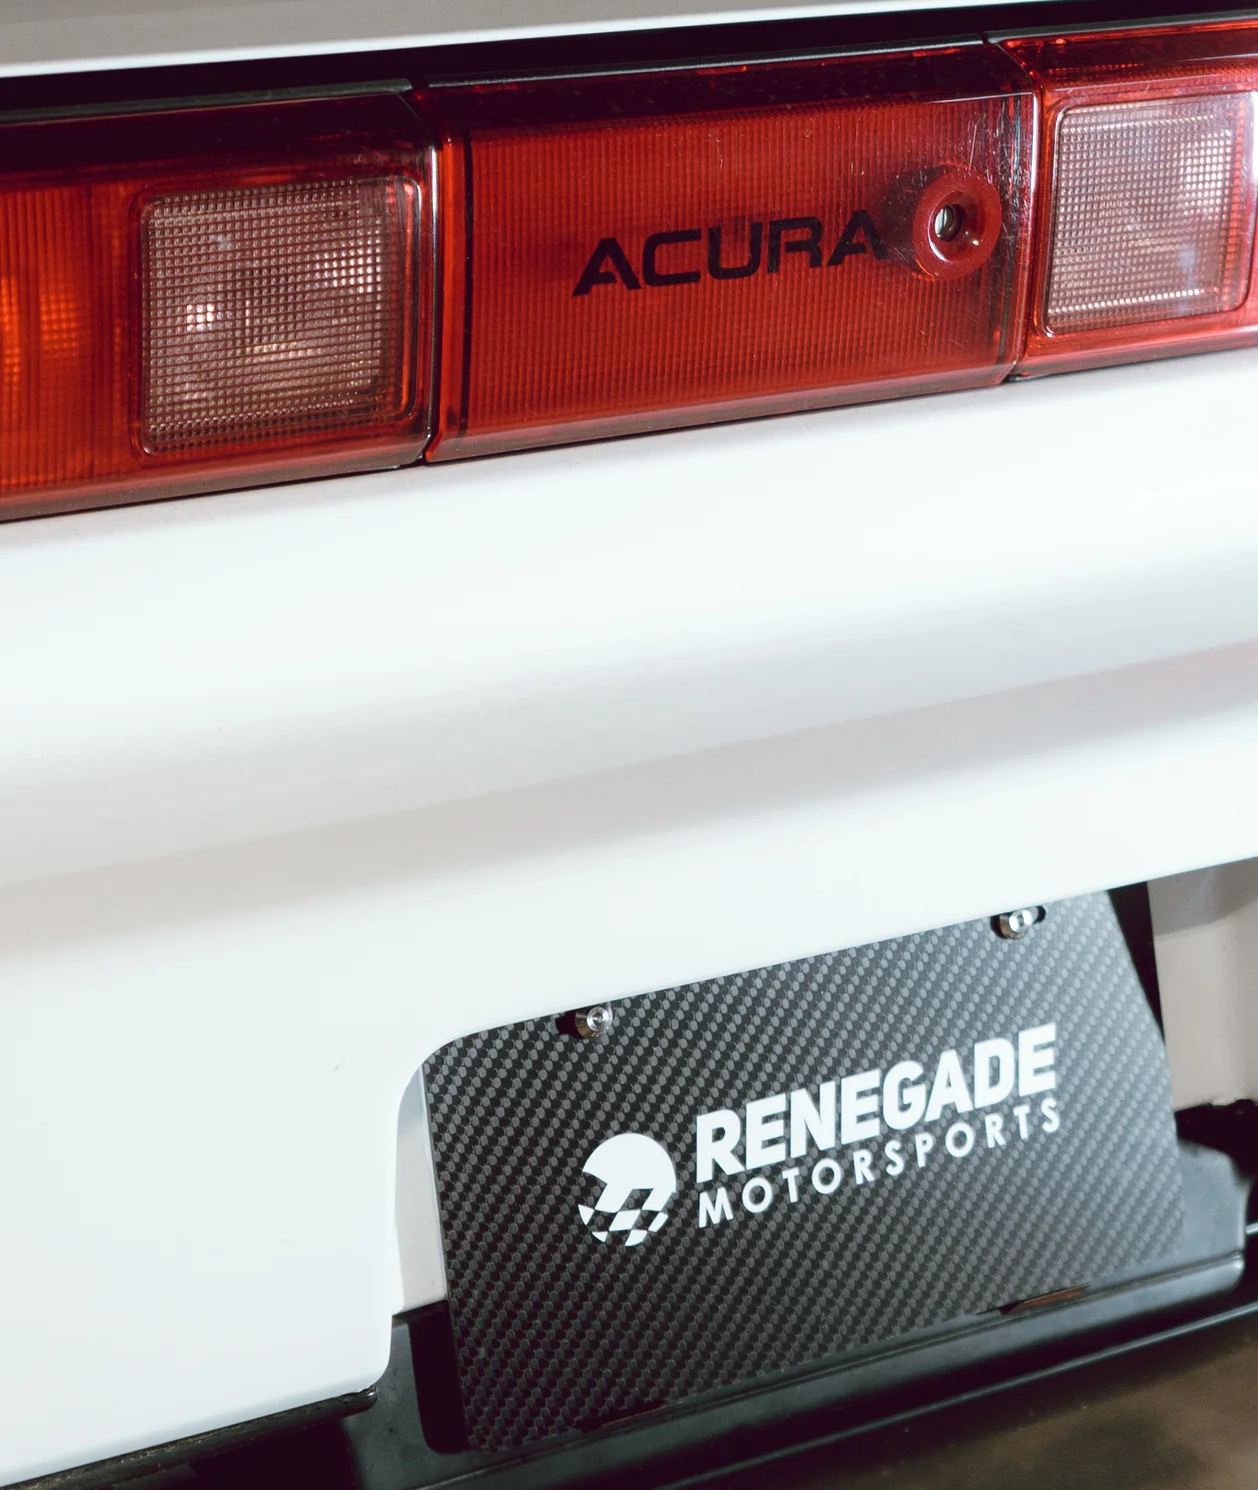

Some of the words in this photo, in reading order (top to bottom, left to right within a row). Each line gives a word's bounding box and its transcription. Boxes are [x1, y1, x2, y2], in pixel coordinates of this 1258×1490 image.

[572, 210, 890, 296] ACURA
[696, 1022, 1057, 1183] RENEGADE
[698, 1098, 1060, 1229] MOTORSPORTS
